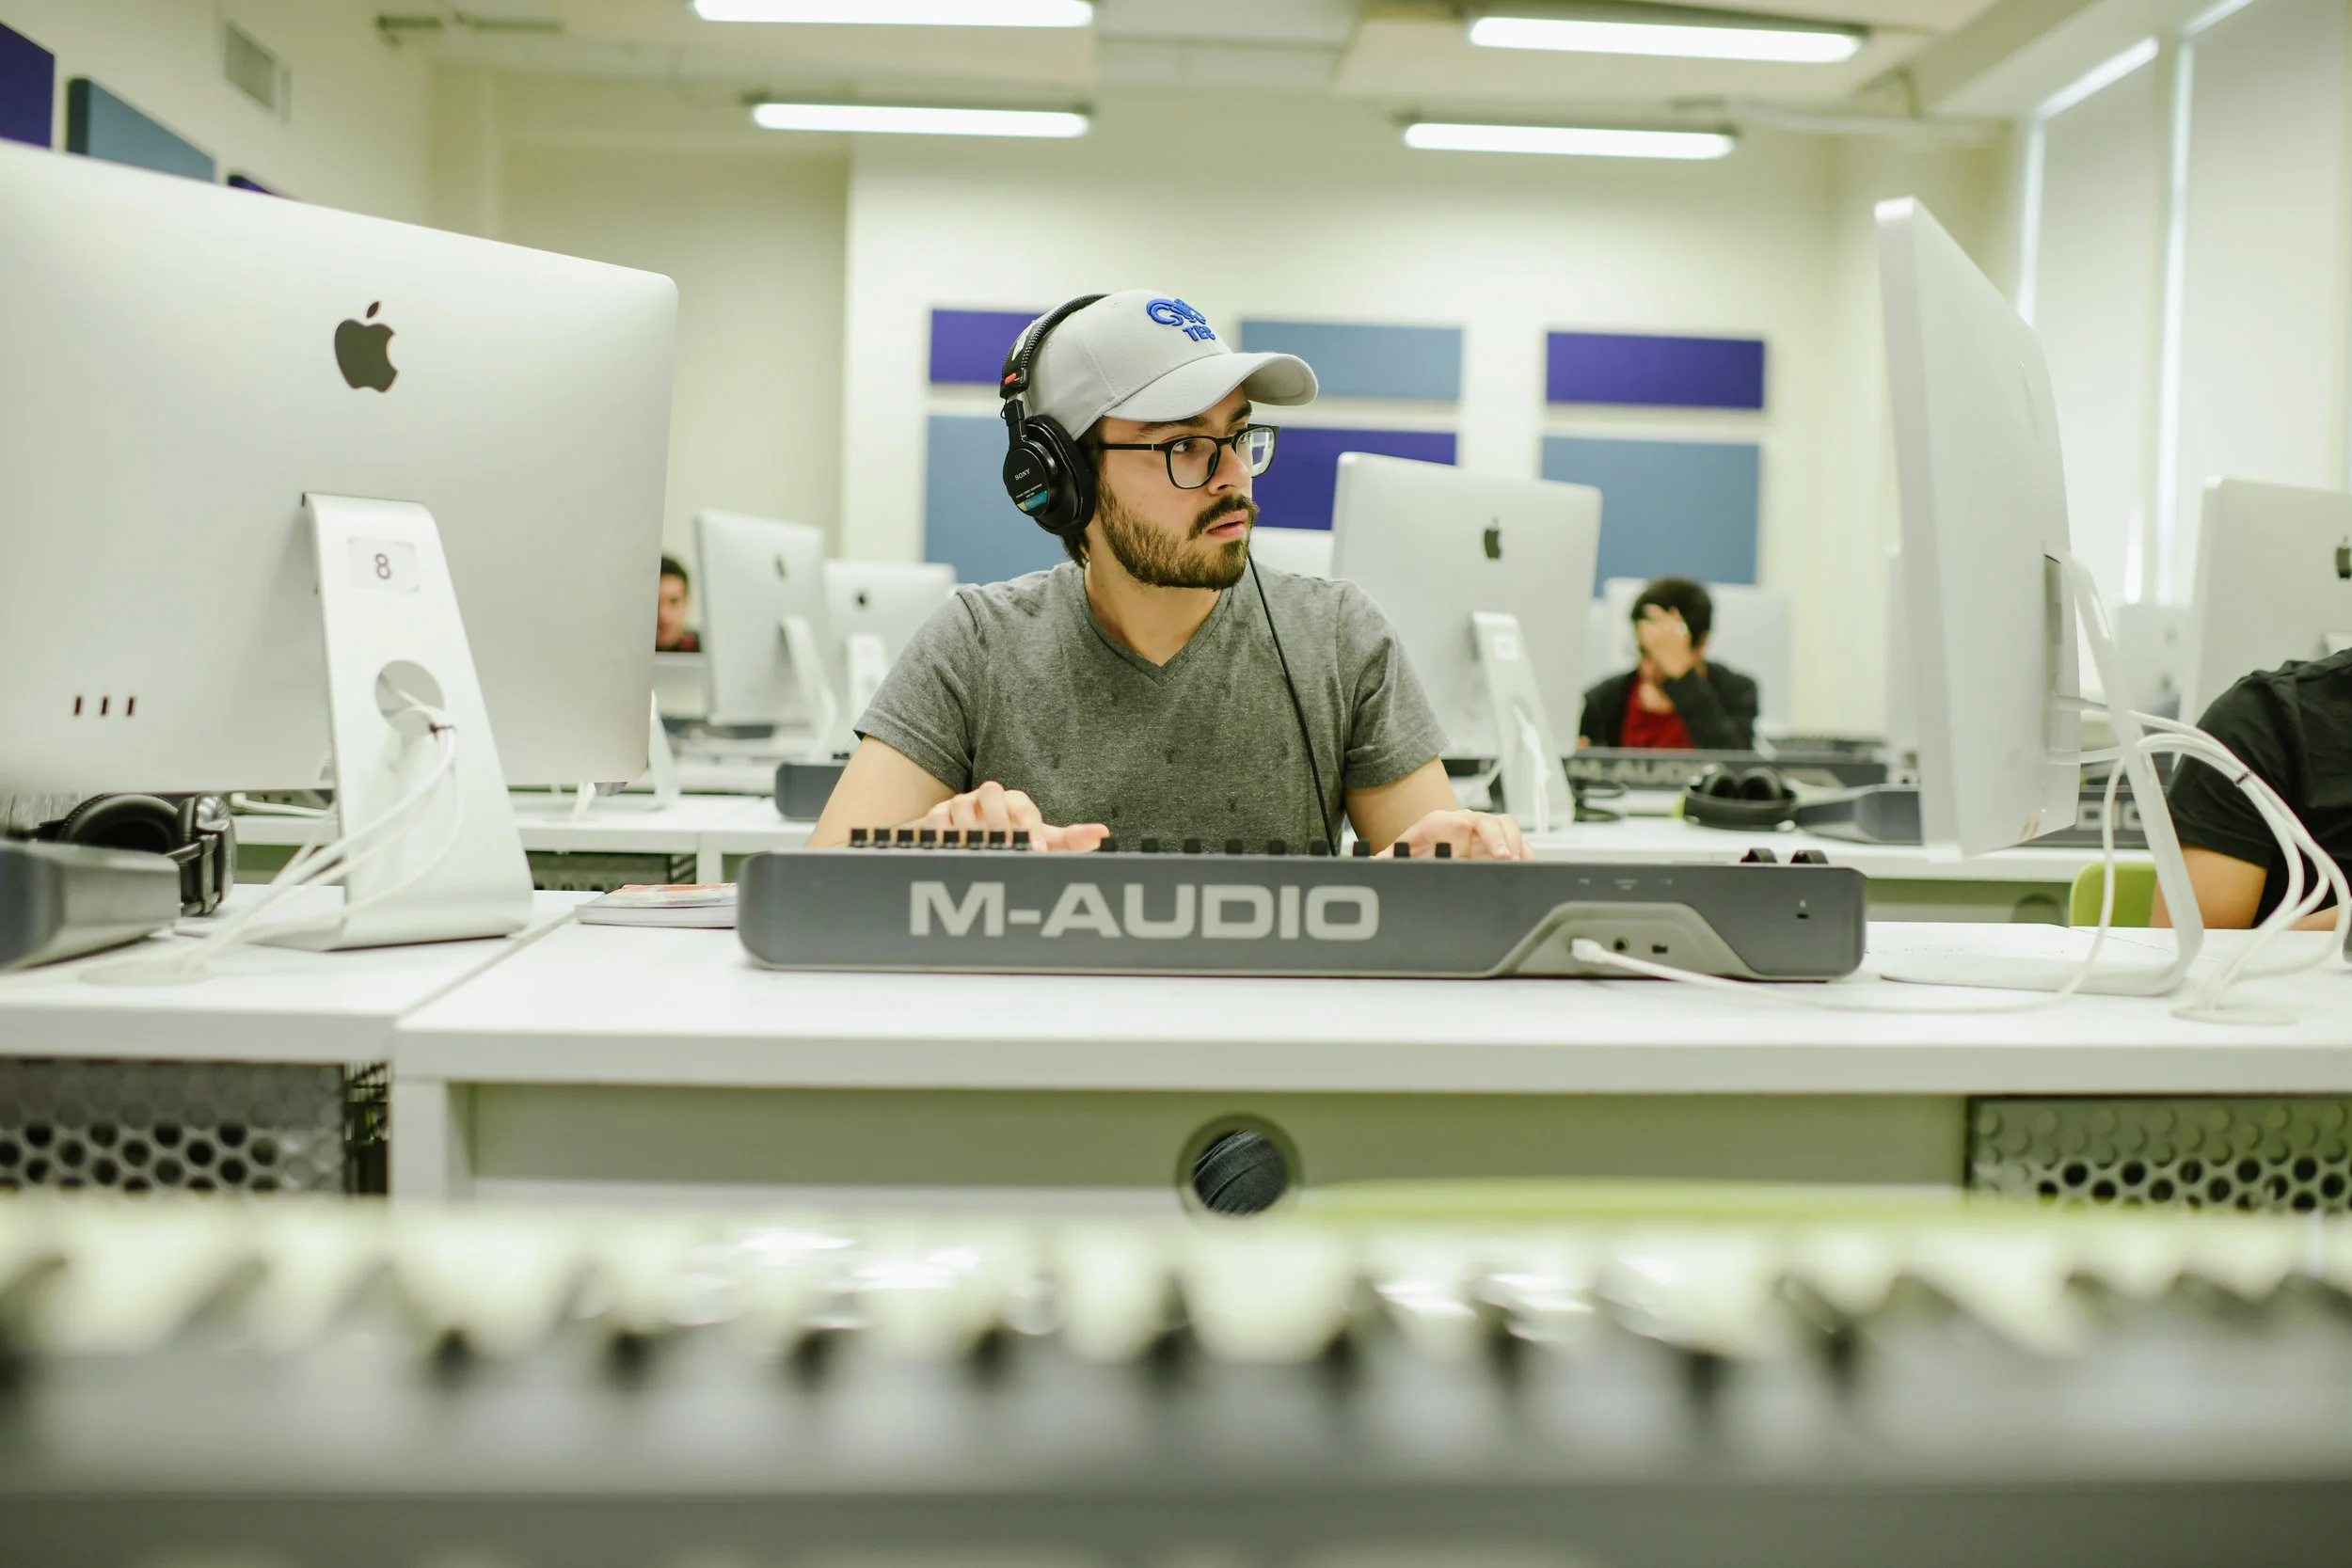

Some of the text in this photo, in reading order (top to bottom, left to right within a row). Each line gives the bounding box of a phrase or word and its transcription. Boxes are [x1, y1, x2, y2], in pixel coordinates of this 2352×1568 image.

[1014, 467, 1030, 481] SONY
[374, 552, 391, 580] 8
[910, 880, 1379, 942] M-AUDIO
